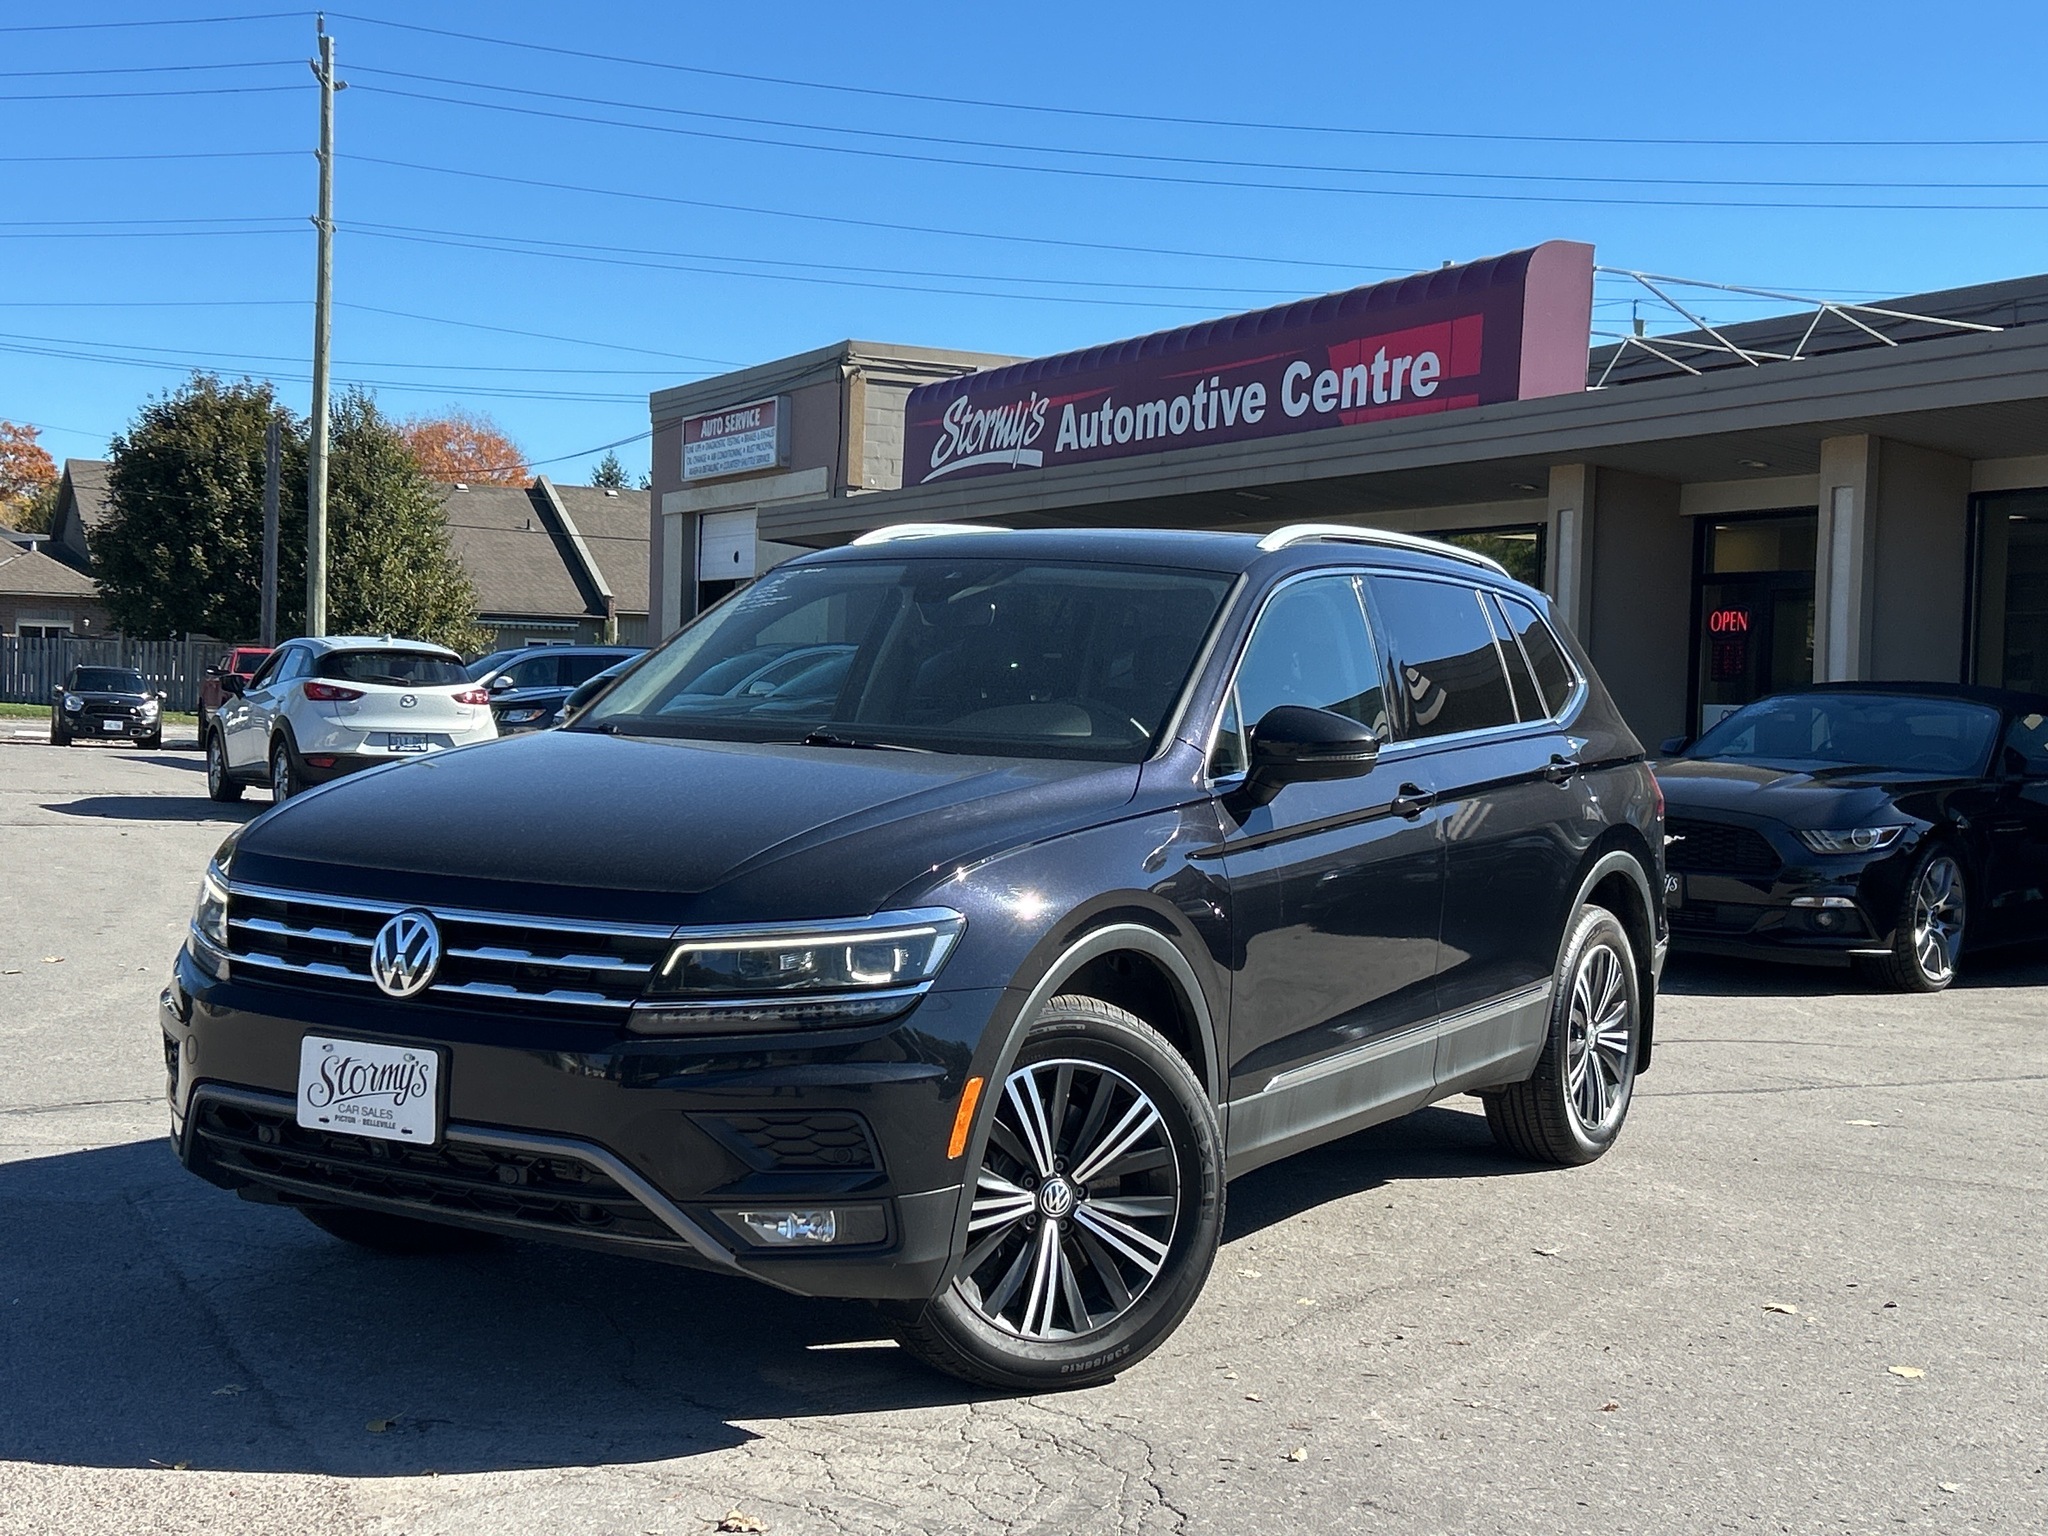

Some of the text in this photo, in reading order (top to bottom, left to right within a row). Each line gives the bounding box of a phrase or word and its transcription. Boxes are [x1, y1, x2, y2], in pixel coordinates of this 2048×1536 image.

[931, 345, 1441, 469] Stormy's Automotive Centre
[701, 408, 760, 437] AUTO SERVICE
[1710, 611, 1748, 632] OPEN
[307, 1055, 429, 1108] Stormy's
[334, 1114, 397, 1130] PICTON BELLEVILLE
[338, 1103, 394, 1120] CAR SALES
